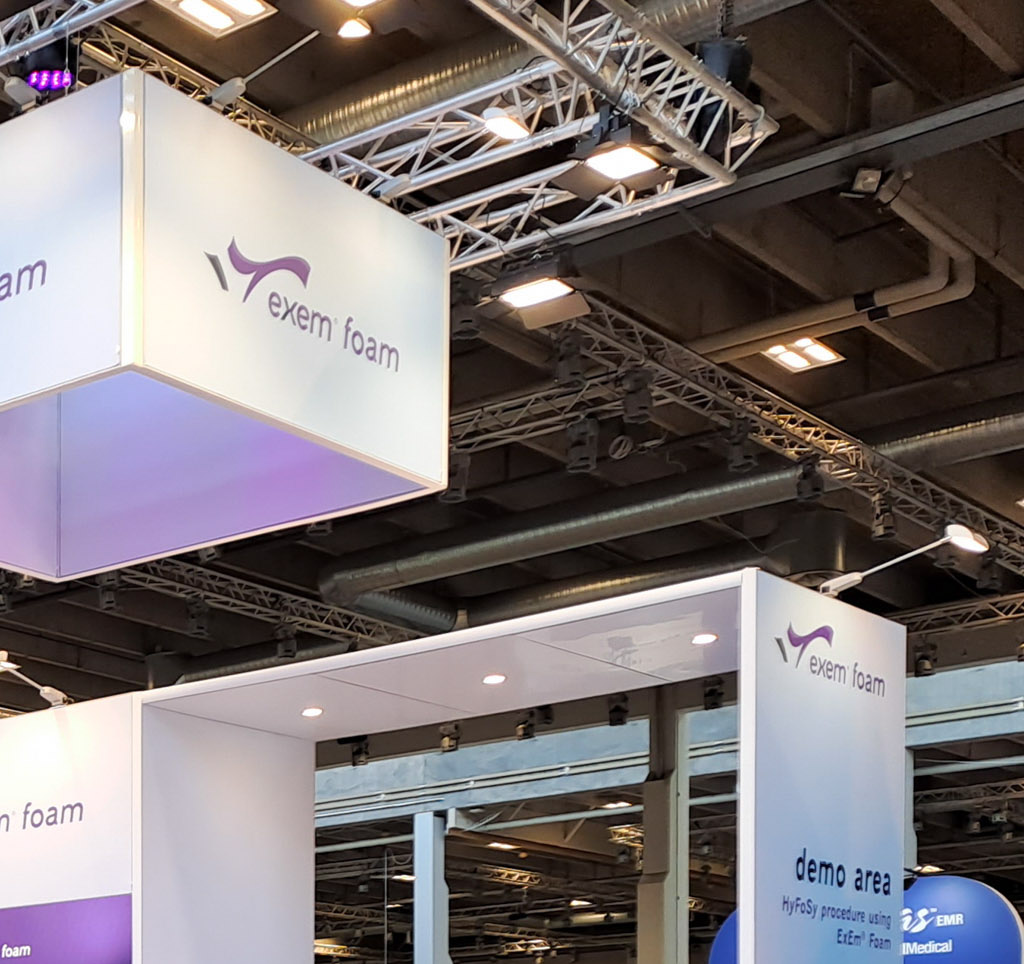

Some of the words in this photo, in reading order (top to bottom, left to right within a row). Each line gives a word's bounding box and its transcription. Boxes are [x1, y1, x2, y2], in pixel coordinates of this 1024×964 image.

[343, 316, 400, 373] foam
[852, 662, 886, 698] foam
[22, 802, 84, 830] foam
[796, 847, 846, 888] demo
[854, 867, 891, 896] area
[782, 895, 818, 919] HyFoSy
[821, 905, 866, 922] procedure
[868, 911, 892, 931] using
[936, 913, 964, 927] EMR
[1, 944, 31, 958] foam
[869, 933, 892, 950] Foam
